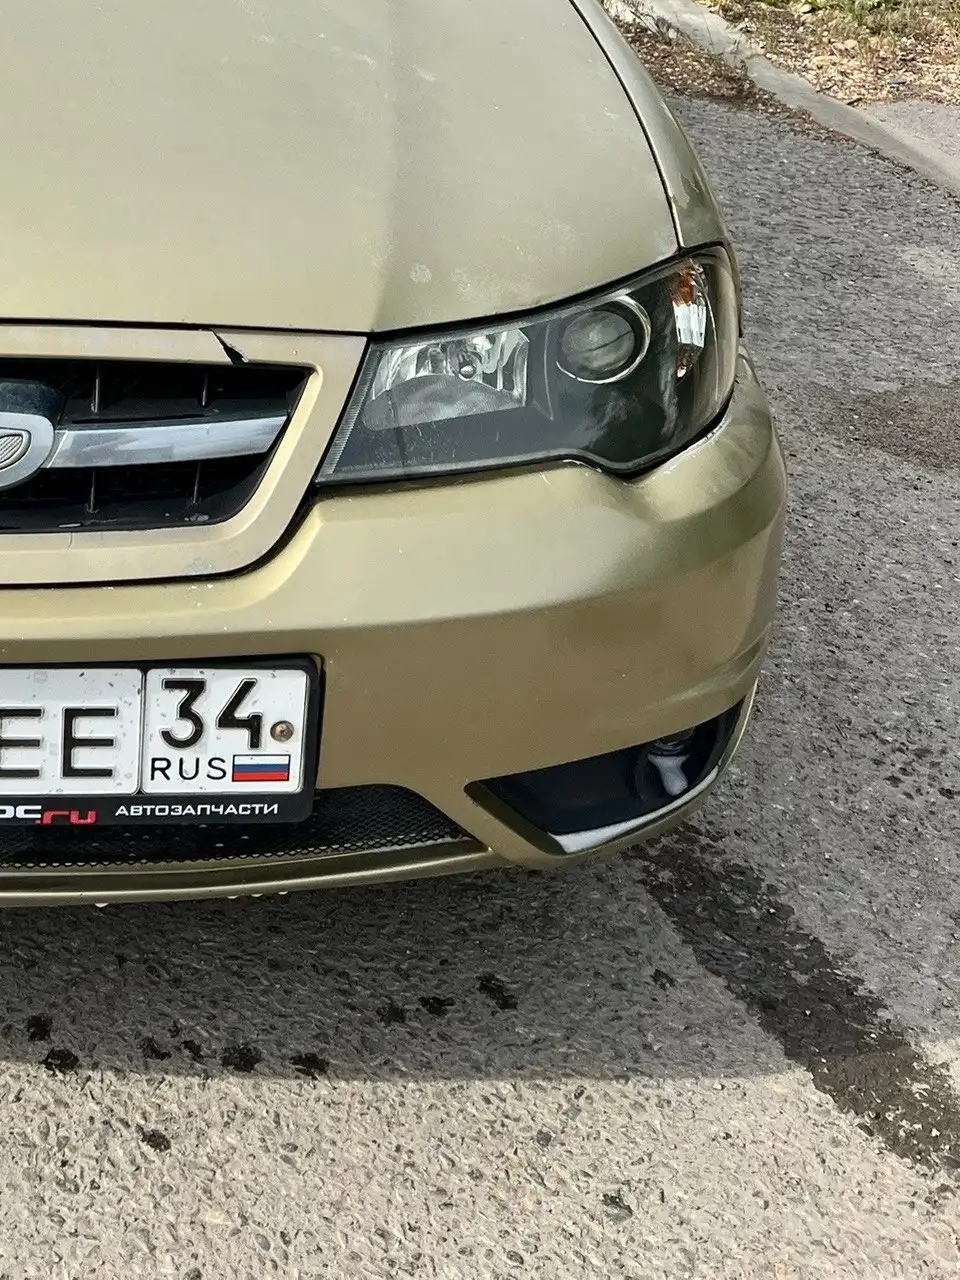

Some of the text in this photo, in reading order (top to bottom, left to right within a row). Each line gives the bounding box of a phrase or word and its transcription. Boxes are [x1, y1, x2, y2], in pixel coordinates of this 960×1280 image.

[160, 677, 263, 750] 34
[150, 756, 228, 781] RUS
[114, 802, 280, 816] АВТОЗАПЧАСТИ
